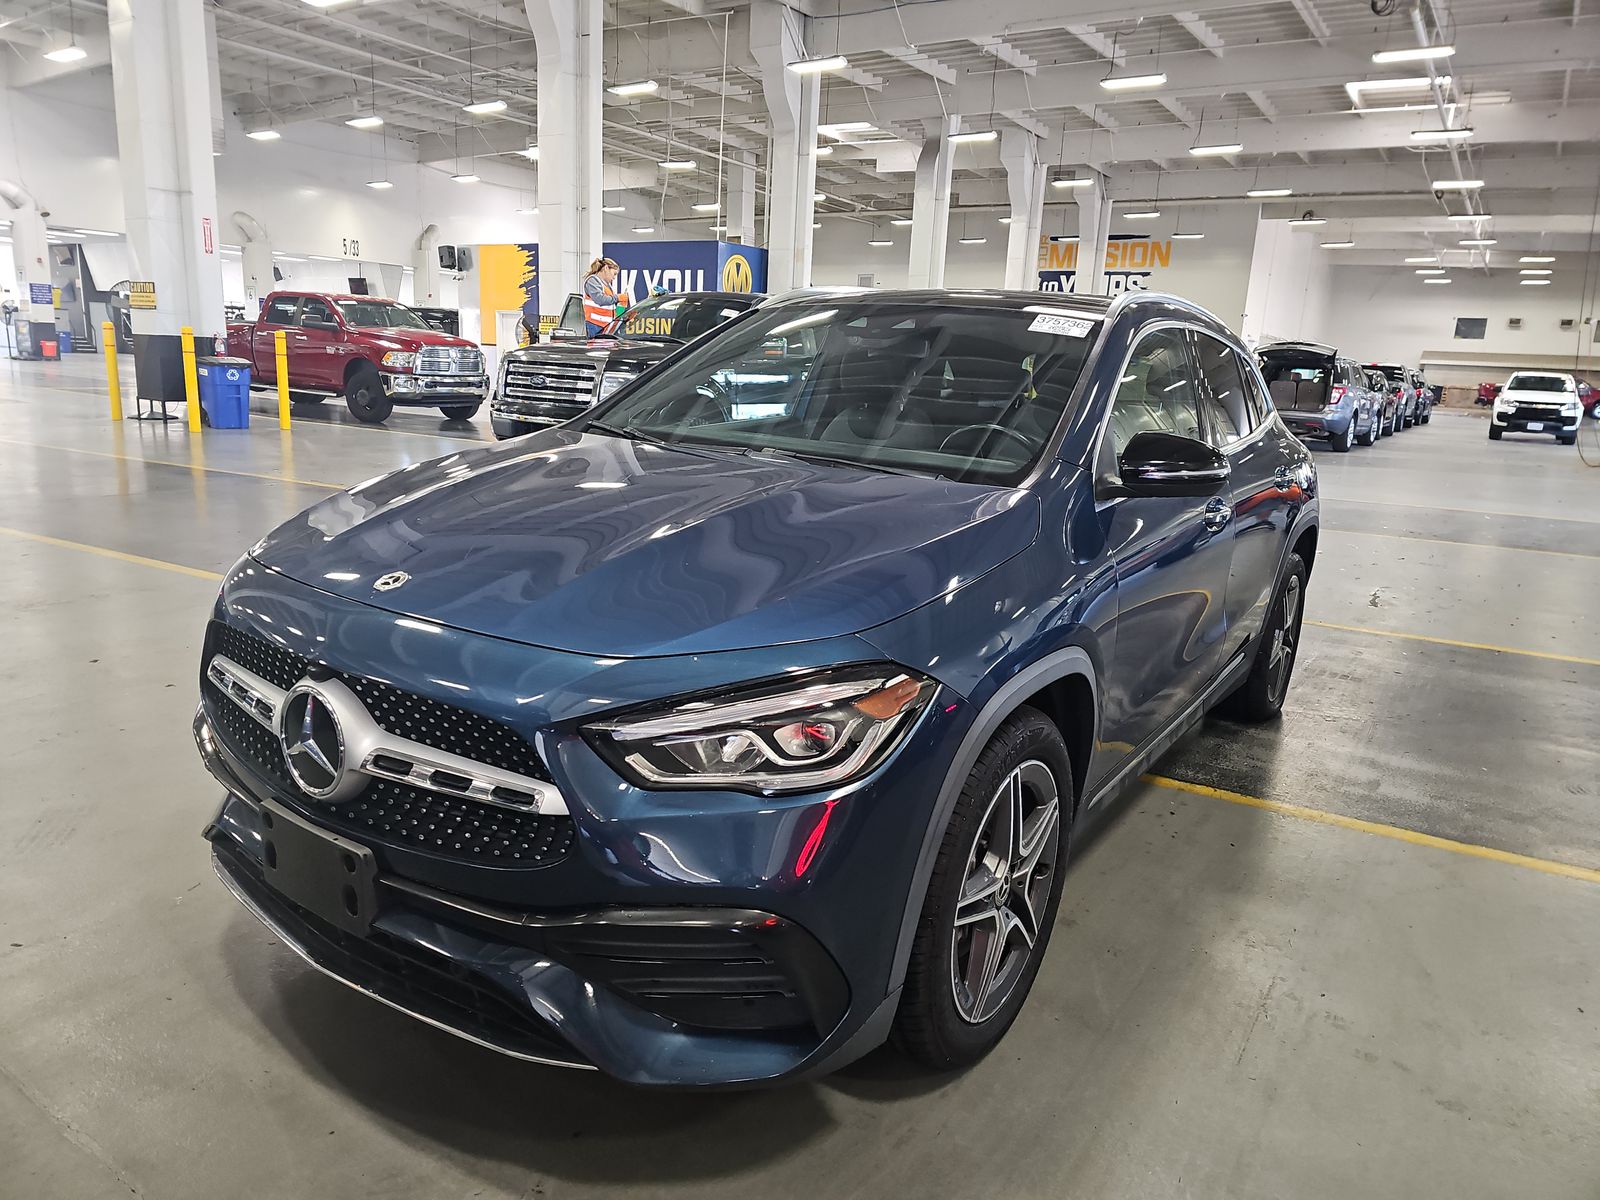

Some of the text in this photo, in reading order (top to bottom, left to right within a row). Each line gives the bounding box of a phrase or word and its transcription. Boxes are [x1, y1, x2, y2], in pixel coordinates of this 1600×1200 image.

[343, 238, 348, 255] 5
[1050, 241, 1171, 269] MISION
[130, 282, 154, 293] CAUTION
